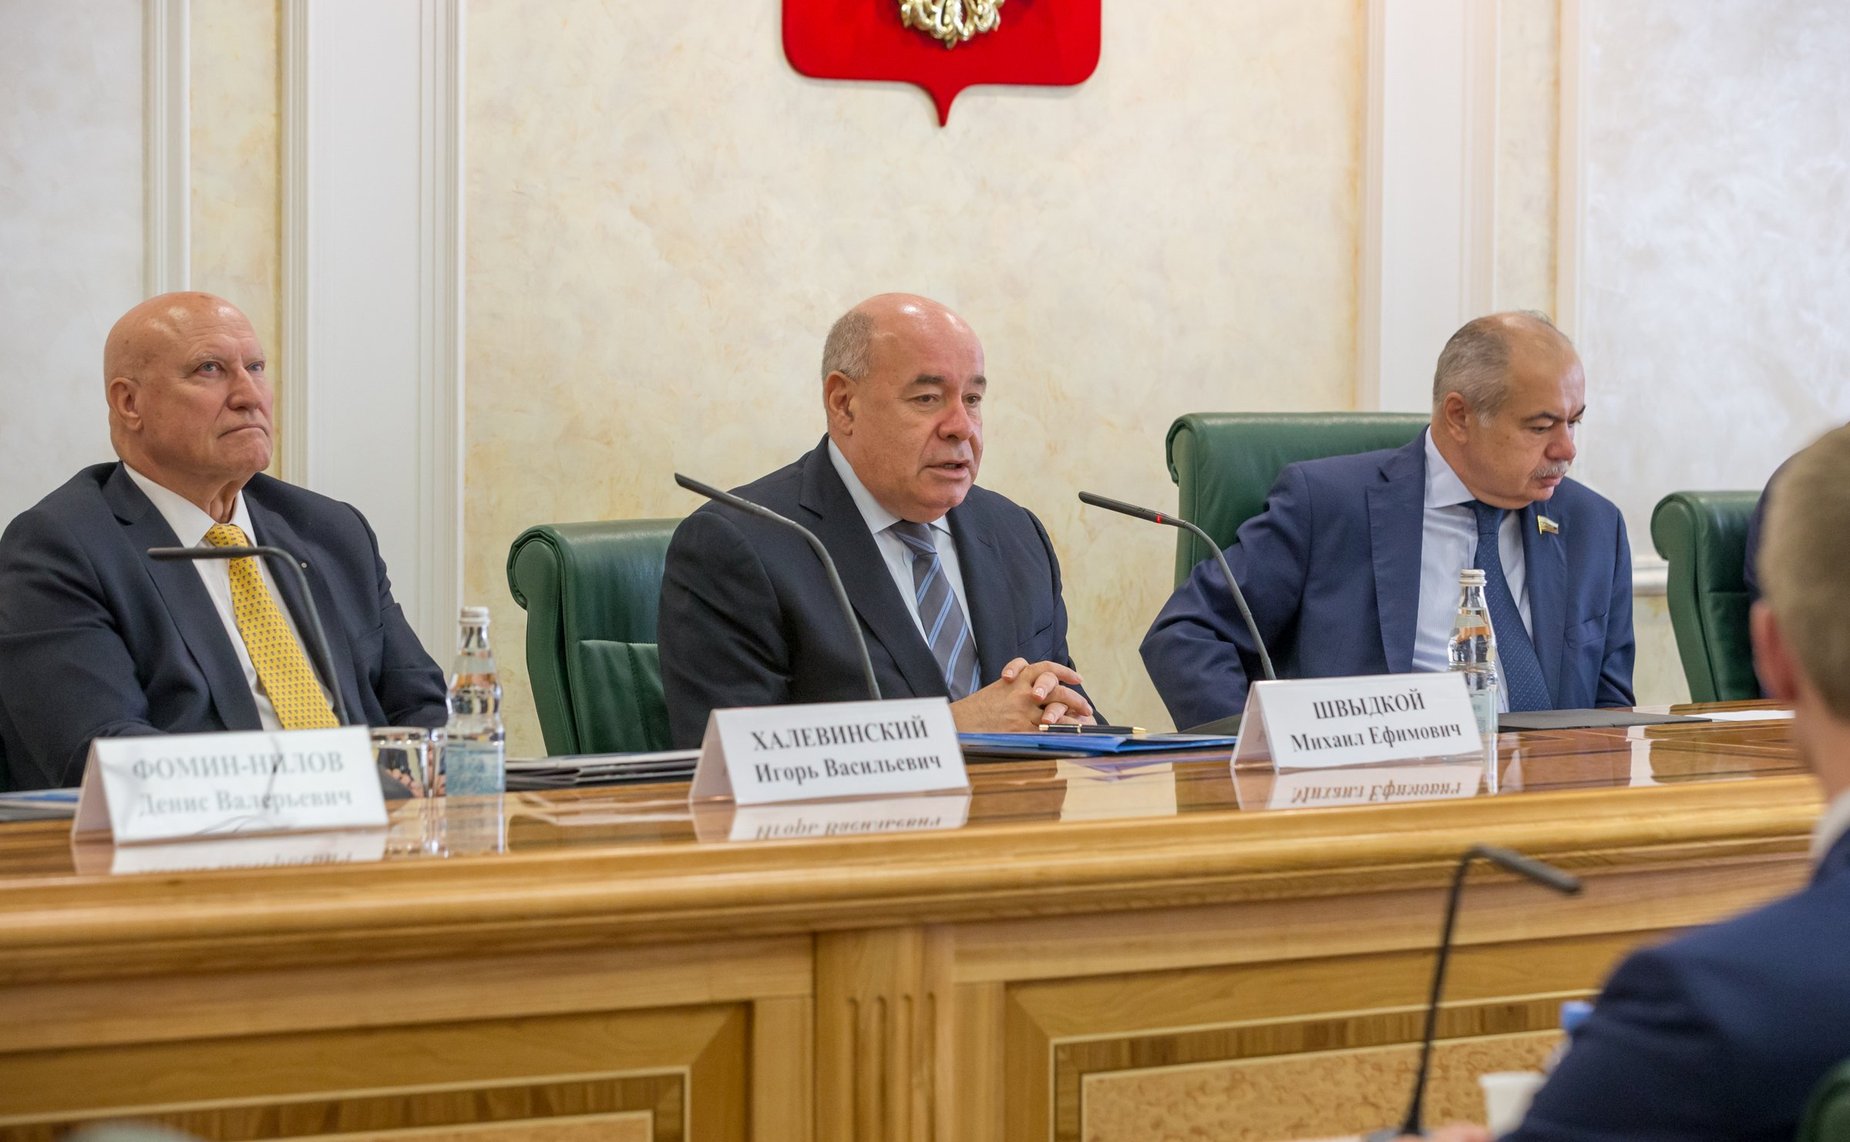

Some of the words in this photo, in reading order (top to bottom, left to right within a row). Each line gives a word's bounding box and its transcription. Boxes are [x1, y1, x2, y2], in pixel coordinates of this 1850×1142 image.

[1312, 688, 1426, 720] ШВЫДКОЙ
[750, 715, 929, 751] ХАЛЕВИНСКИЙ
[1290, 731, 1365, 753] Михаил
[1368, 723, 1462, 748] Ефимович
[754, 763, 819, 786] Игорь
[823, 755, 942, 778] Васильевич
[139, 793, 208, 817] Денис
